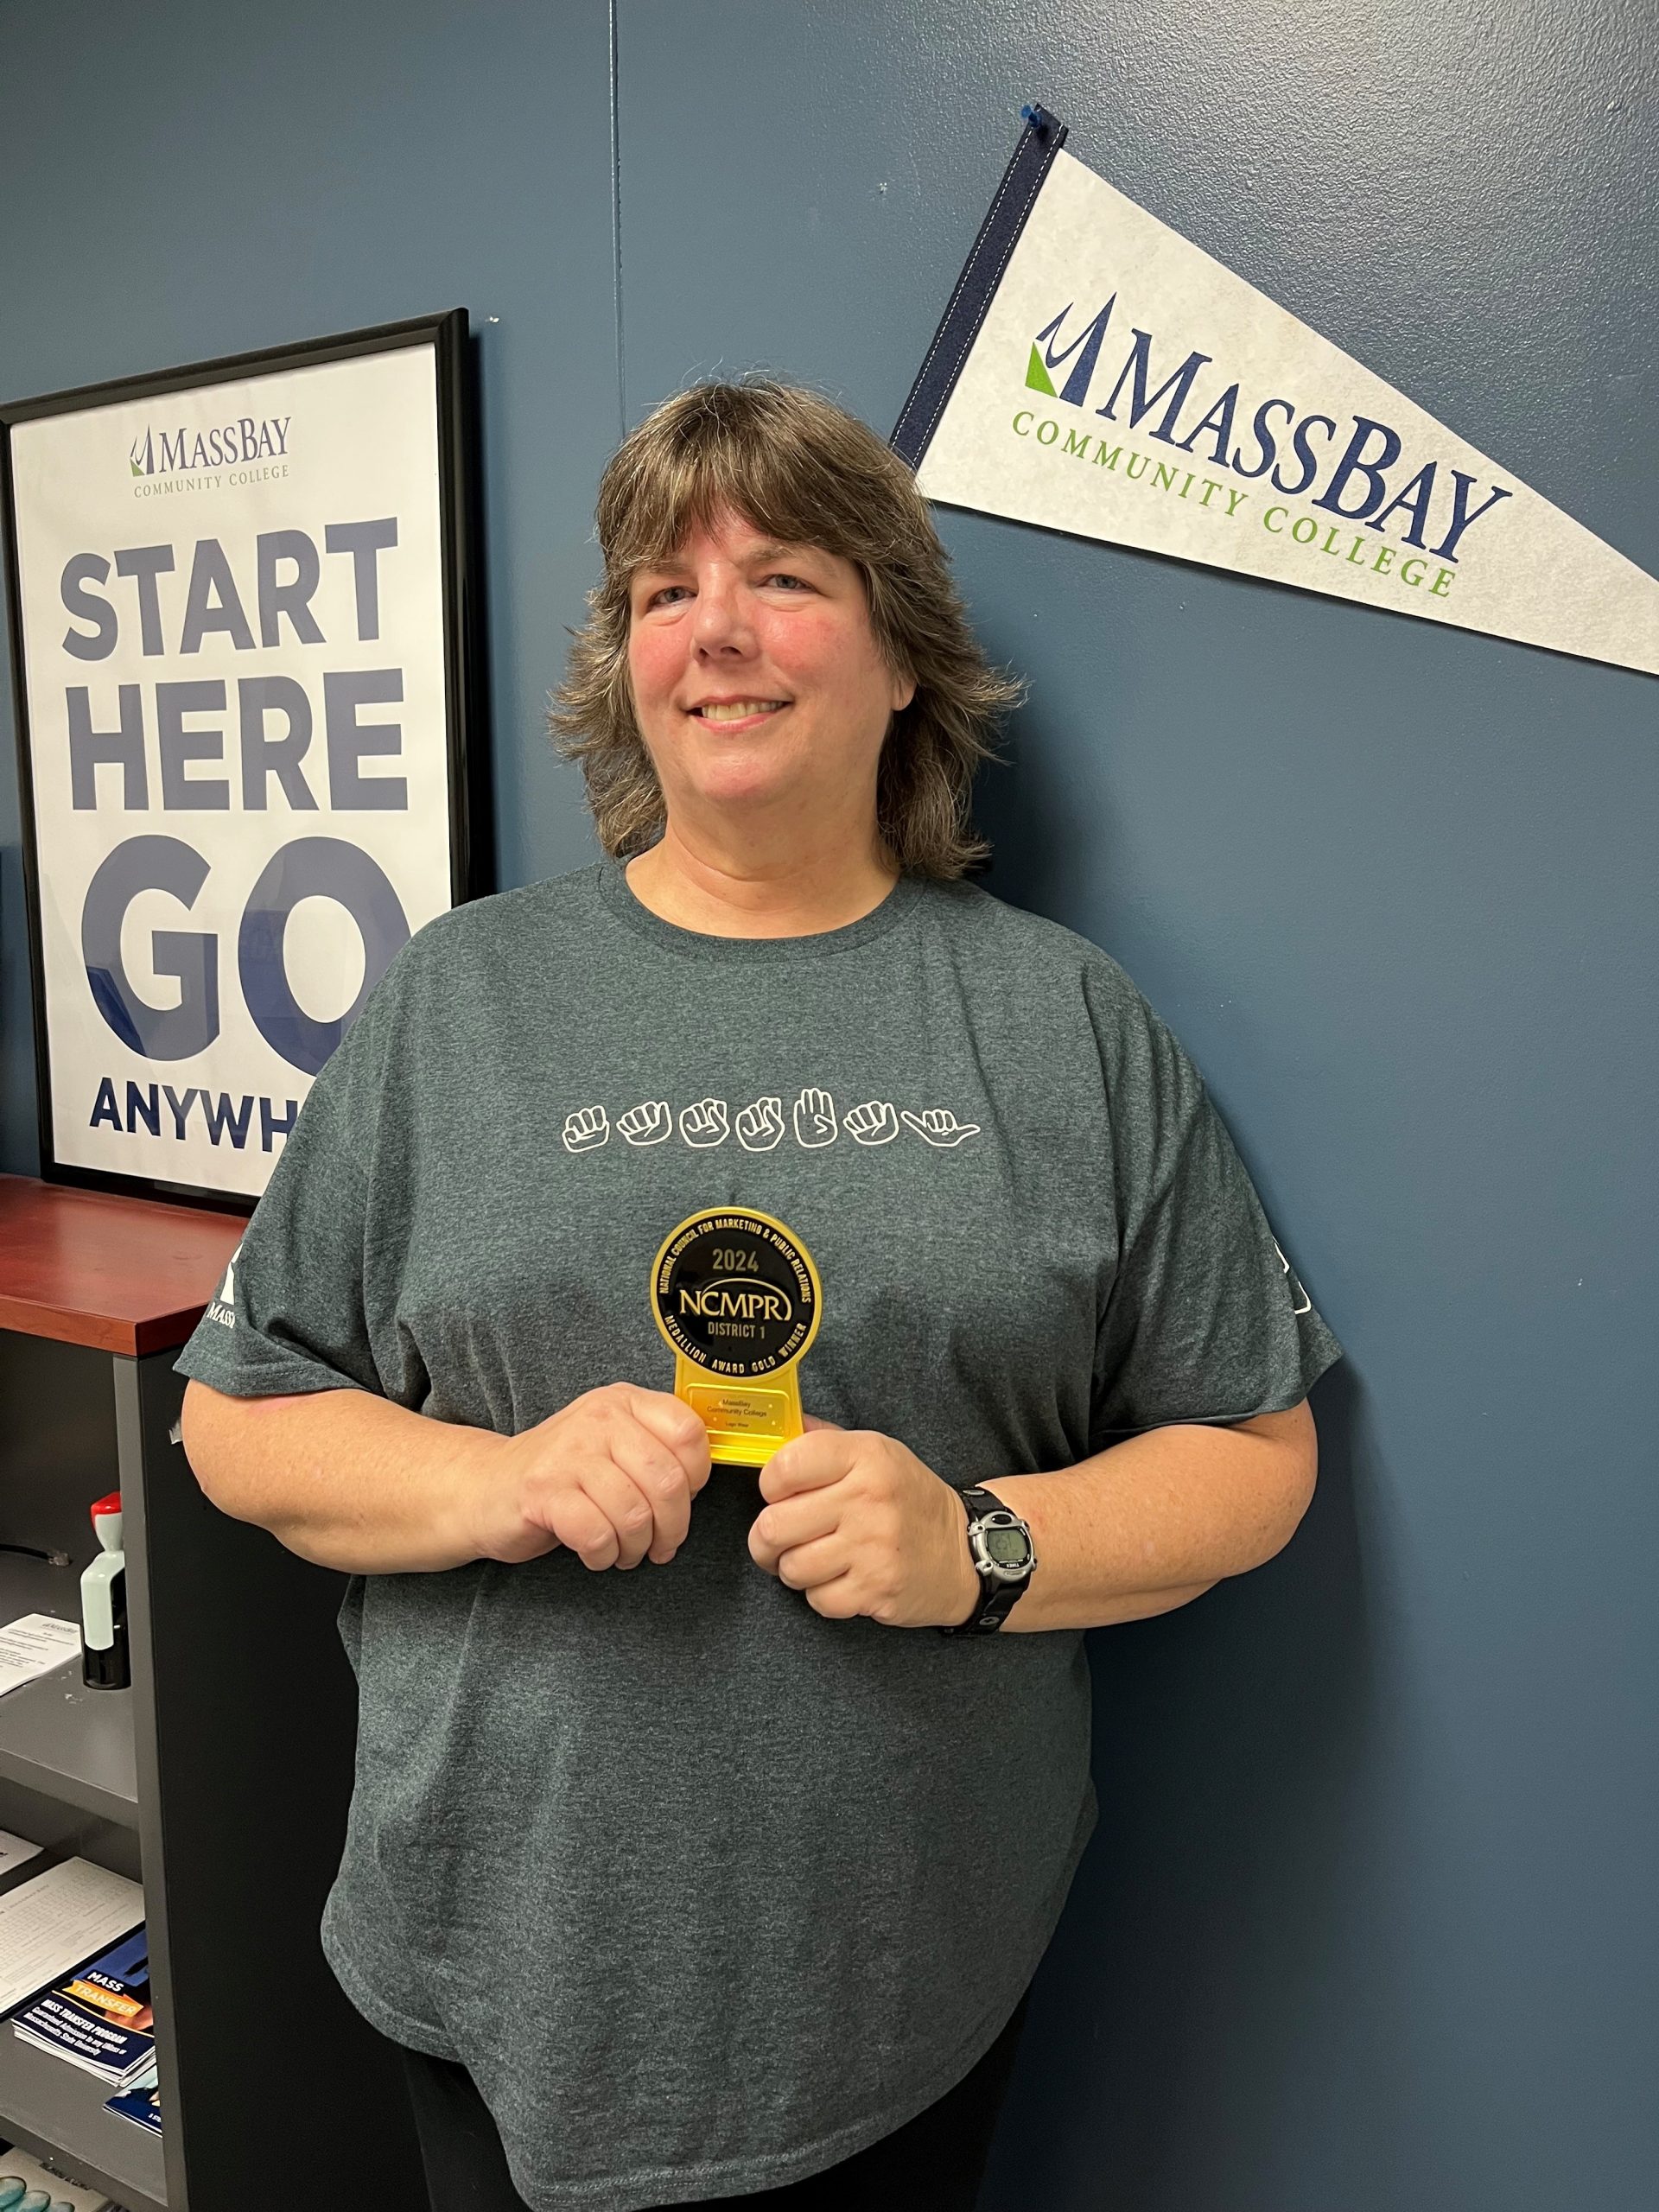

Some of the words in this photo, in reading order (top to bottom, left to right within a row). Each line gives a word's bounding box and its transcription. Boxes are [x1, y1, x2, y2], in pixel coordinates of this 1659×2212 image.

[159, 416, 291, 473] MASSBAY
[1096, 327, 1513, 564] MASSBAY
[134, 475, 222, 498] COMMUNITY
[229, 465, 289, 486] COLLEGE
[1012, 410, 1249, 518] COMMUNITY
[1263, 505, 1457, 598] COLLEGE
[60, 517, 398, 662] START
[66, 668, 408, 810] HERE
[81, 835, 412, 1078] GO
[658, 1255, 677, 1294] NATIONAL
[671, 1229, 699, 1256] COUNCIL
[697, 1221, 715, 1235] FOR
[715, 1218, 762, 1235] MARKETING
[762, 1228, 771, 1238] &
[770, 1233, 796, 1261] PUBLIC
[790, 1258, 811, 1304] RELATIONS
[712, 1248, 760, 1272] 2024
[679, 1289, 785, 1321] NCMPR
[708, 1321, 755, 1338] DISTRICT
[760, 1326, 766, 1338] 1
[664, 1314, 707, 1363] MEDALLION
[711, 1358, 745, 1374] AWARD
[752, 1355, 776, 1373] GOLD
[778, 1322, 807, 1357] WINNER
[707, 1405, 742, 1416] Community
[743, 1408, 767, 1418] College
[74, 1984, 137, 2014] TRANSFER
[87, 1971, 124, 1993] MASS
[41, 1999, 62, 2014] MASS
[60, 2007, 95, 2032] TRANSFER
[92, 2023, 128, 2044] PROGRAM
